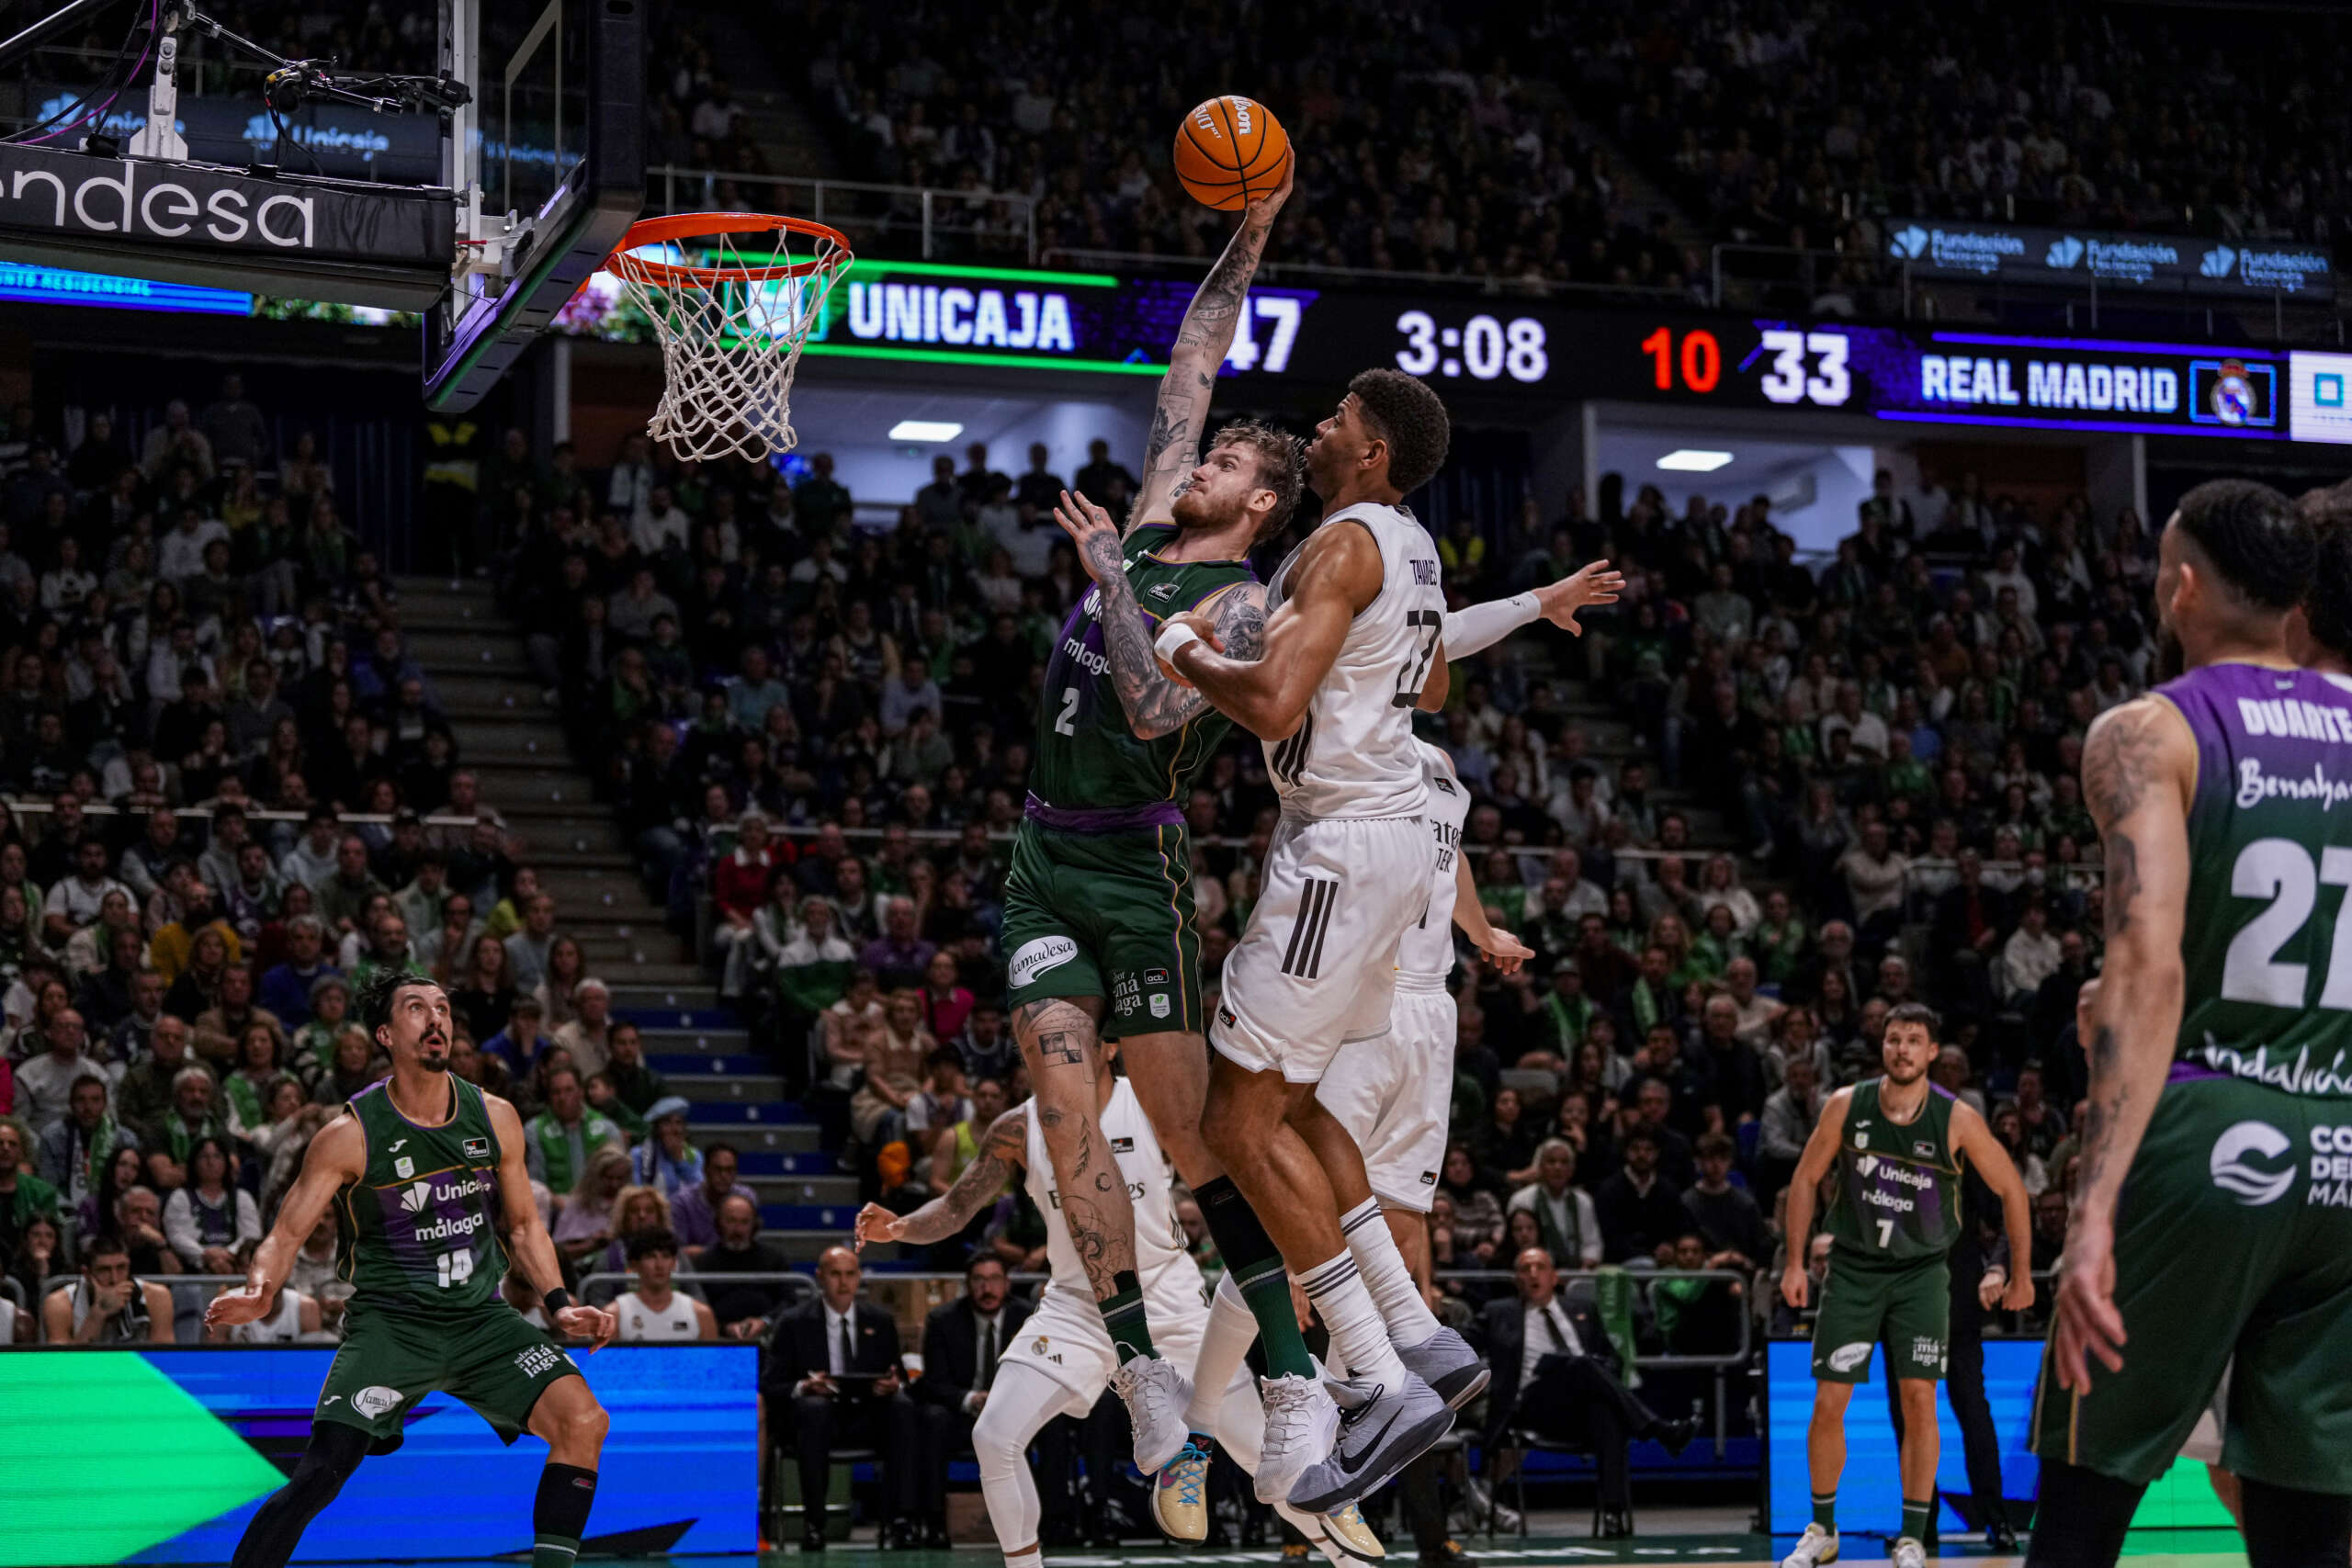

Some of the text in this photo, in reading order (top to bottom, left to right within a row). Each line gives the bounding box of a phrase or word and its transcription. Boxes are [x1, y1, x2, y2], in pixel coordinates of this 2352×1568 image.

[0, 162, 314, 249] ndesa
[847, 281, 1076, 351] UNICAJA
[1224, 296, 1302, 373] 47
[1396, 310, 1548, 383] 3:08
[1641, 325, 1721, 393] 10
[1760, 329, 1850, 406] 33
[1921, 355, 2178, 413] REAL MADRID
[1391, 609, 1442, 709] 22
[1055, 686, 1081, 738] 2
[2236, 697, 2352, 744] DUARTE
[2235, 757, 2352, 813] Benaha
[1435, 848, 1454, 874] TER
[1147, 974, 1164, 982] acb
[1879, 1164, 1933, 1191] Unicaja
[2310, 1156, 2352, 1180] DE
[2307, 1179, 2352, 1209] MÁ
[414, 1212, 484, 1242] málaga
[1876, 1218, 1894, 1248] 7
[436, 1247, 474, 1288] 14
[523, 1343, 553, 1368] má
[523, 1354, 561, 1379] laga
